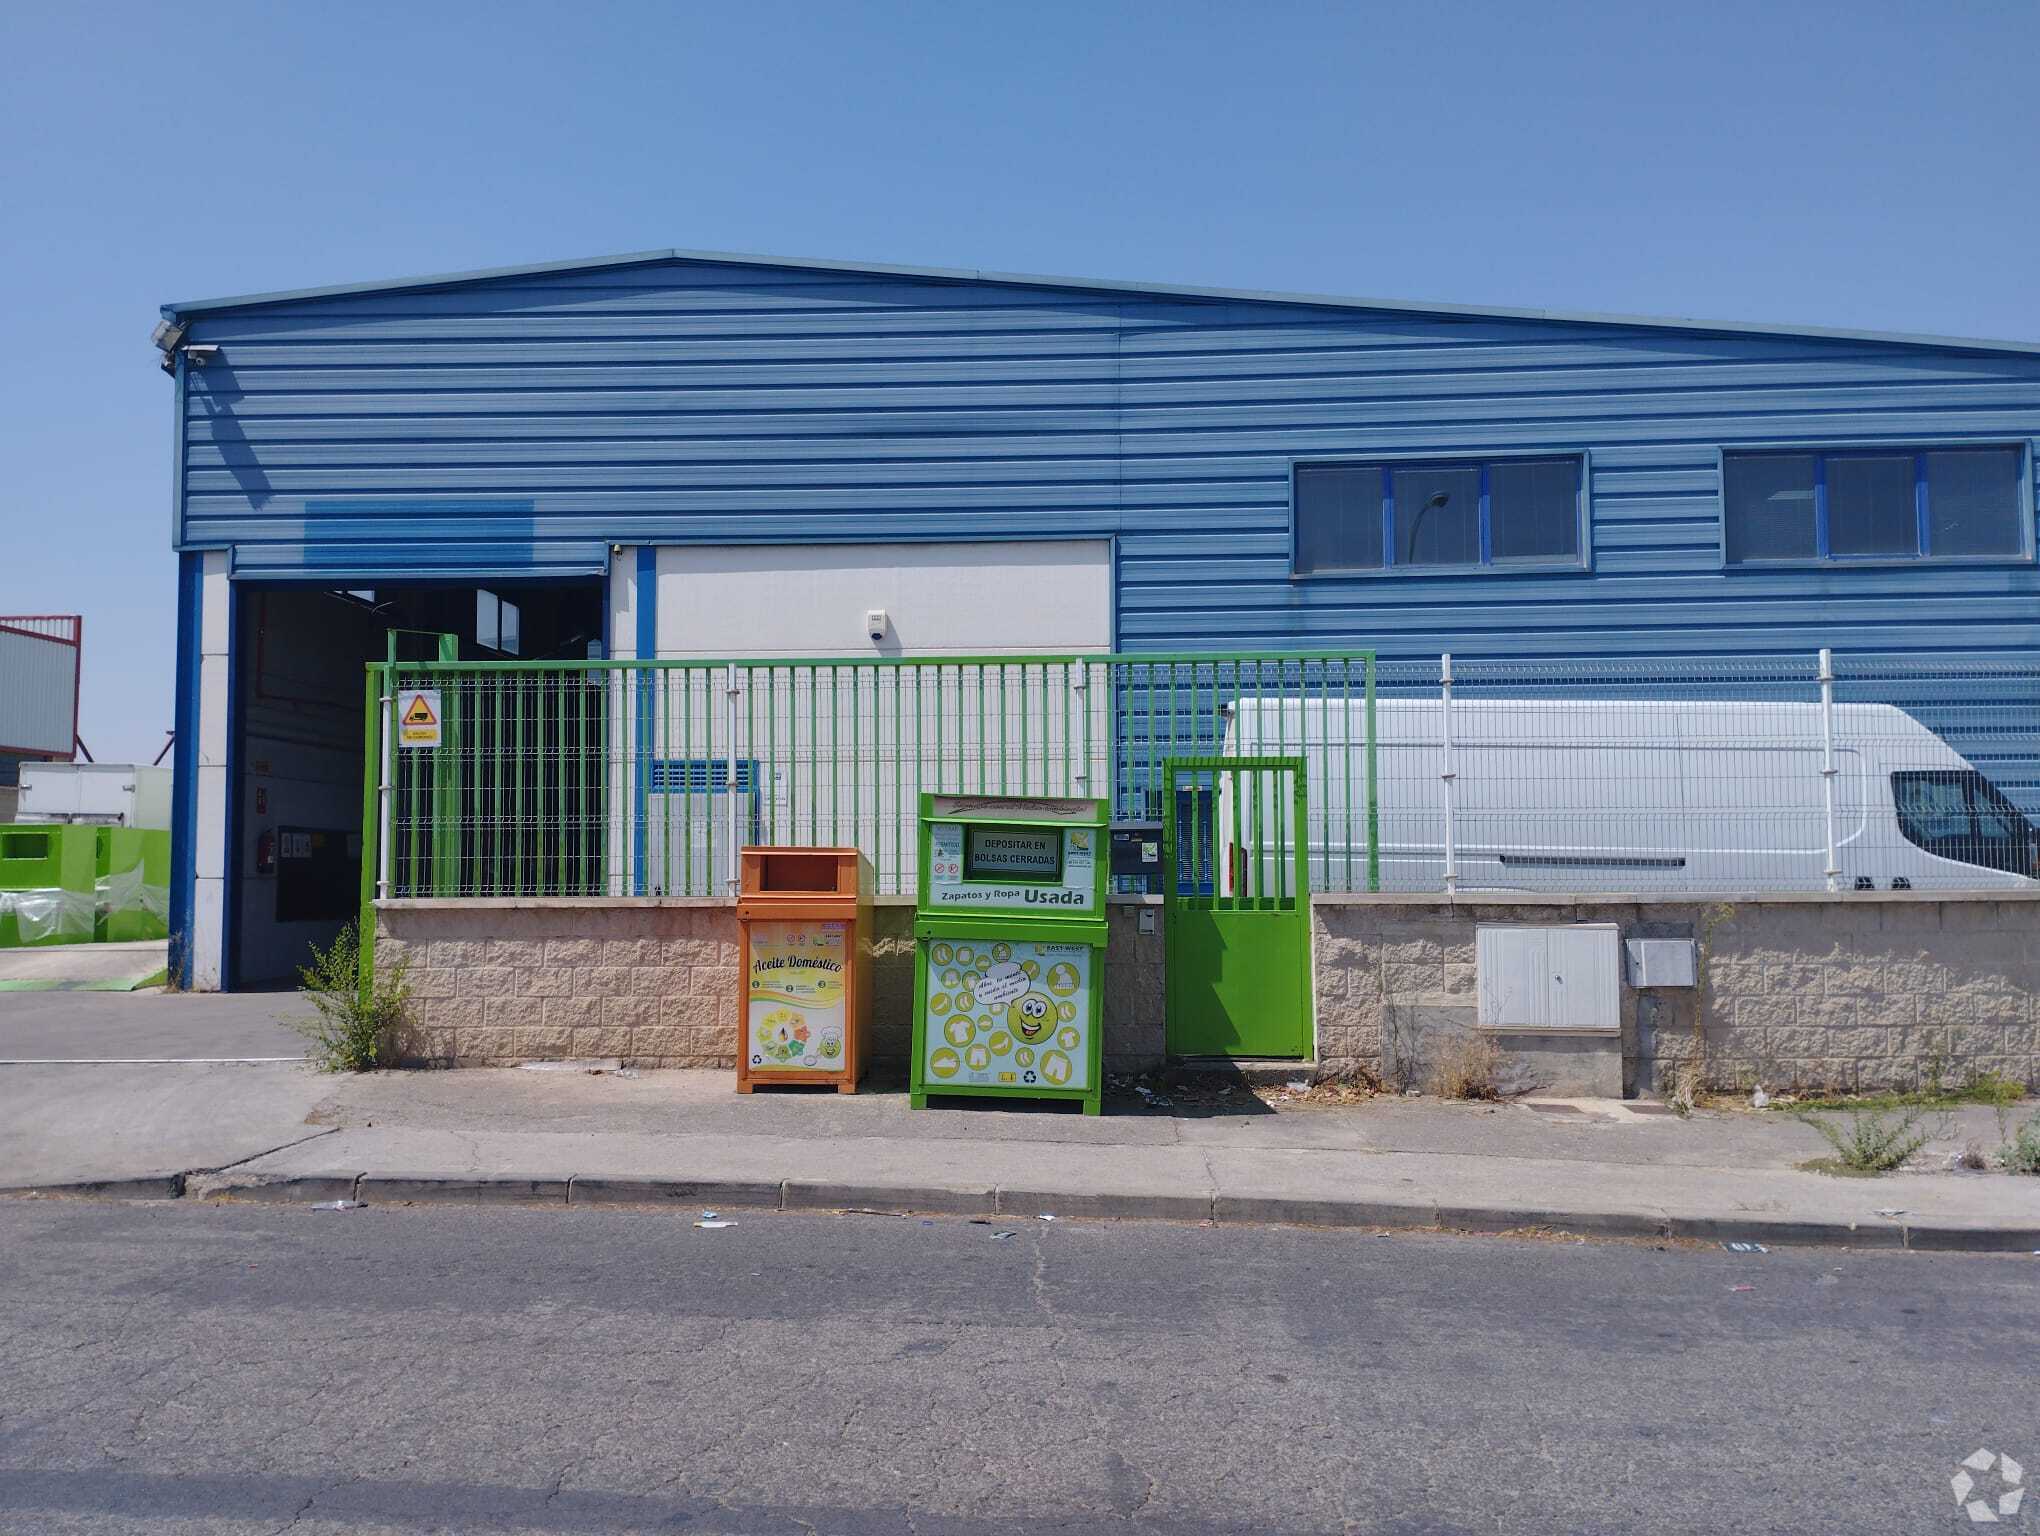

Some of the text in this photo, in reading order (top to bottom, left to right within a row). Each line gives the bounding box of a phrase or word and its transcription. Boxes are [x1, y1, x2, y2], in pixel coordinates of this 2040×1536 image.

[985, 839, 1046, 850] DEPOSITAR EN
[975, 853, 1008, 863] BOLSAS
[1009, 854, 1055, 865] CERRADAS
[942, 889, 1084, 905] Zapatos y Ropa Usada
[753, 955, 842, 974] Aceite Doméstico
